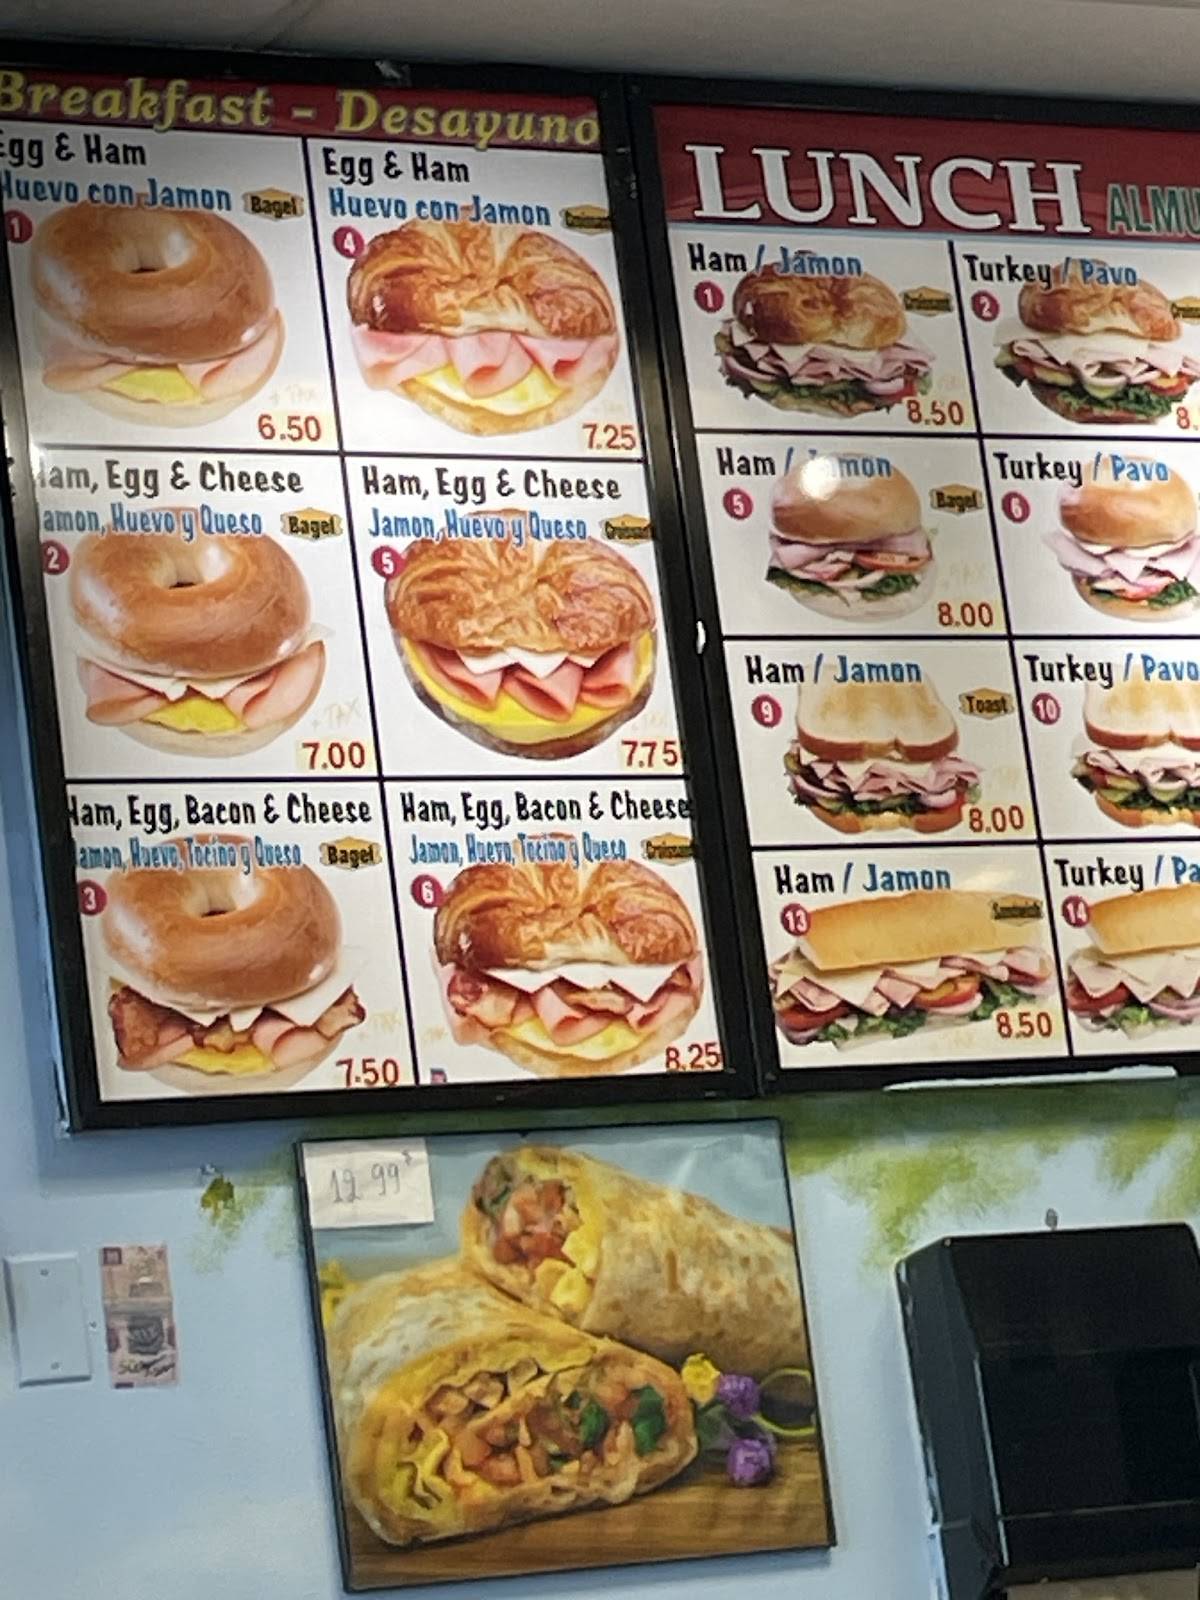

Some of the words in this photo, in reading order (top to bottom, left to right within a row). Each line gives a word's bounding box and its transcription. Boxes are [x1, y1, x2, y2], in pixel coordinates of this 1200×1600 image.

[0, 70, 273, 132] Breakfast
[335, 88, 599, 151] Desayuno
[55, 132, 75, 161] &
[84, 134, 147, 166] Ham
[323, 148, 374, 186] Egg
[384, 150, 402, 179] &
[412, 153, 470, 182] Ham
[88, 181, 133, 202] con
[145, 178, 232, 211] Jamon
[685, 144, 1092, 235] LUNCH
[250, 196, 297, 217] Bagel
[329, 188, 407, 220] Huevo
[416, 200, 457, 220] con
[472, 195, 551, 226] Jamon
[11, 217, 20, 239] 1
[343, 231, 356, 254] 4
[688, 242, 747, 272] Ham
[755, 244, 765, 274] /
[778, 246, 862, 276] Jamon
[963, 254, 1052, 289] Turkey
[1062, 256, 1072, 283] /
[1080, 258, 1137, 286] Pavo
[704, 288, 714, 308] 1
[979, 298, 992, 318] 2
[907, 401, 964, 425] 8.50
[258, 414, 321, 441] 6.50
[582, 424, 637, 450] 7.25
[716, 447, 776, 476] Ham
[785, 447, 794, 476] /
[808, 449, 892, 478] mon
[993, 452, 1082, 488] Turkey
[1093, 452, 1102, 481] /
[1110, 454, 1168, 482] Pavo
[106, 460, 159, 498] Egg
[171, 460, 190, 490] &
[200, 461, 304, 493] Cheese
[362, 466, 429, 500] Ham,
[435, 467, 486, 505] Egg
[497, 469, 515, 496] &
[524, 469, 622, 499] Cheese
[732, 494, 744, 515] 5
[1011, 497, 1022, 517] 6
[43, 510, 106, 537] amon,
[111, 503, 174, 533] Huevo
[181, 512, 196, 541] y
[201, 505, 262, 535] Queso
[289, 515, 336, 539] Bagel
[368, 508, 441, 541] Jamon,
[446, 509, 504, 538] Huevo
[512, 517, 525, 546] y
[529, 511, 587, 540] Queso
[47, 549, 59, 571] 2
[382, 552, 394, 573] 5
[937, 602, 993, 627] 8.00
[745, 655, 804, 684] Ham
[813, 653, 824, 684] /
[833, 655, 922, 684] Jamon
[1023, 654, 1113, 690] Turkey
[1123, 653, 1133, 681] /
[1141, 654, 1200, 681] Pavo
[762, 703, 772, 722] 9
[966, 695, 1006, 713] Toast
[1036, 699, 1056, 720] 10
[302, 742, 365, 770] 7.00
[621, 740, 678, 768] 7.75
[128, 795, 180, 834] Egg,
[186, 795, 256, 826] Bacon
[264, 793, 280, 823] &
[287, 793, 372, 824] Cheese
[400, 792, 456, 826] Ham,
[460, 793, 511, 830] Egg,
[516, 793, 582, 821] Bacon
[589, 792, 605, 820] &
[610, 791, 692, 819] Cheese
[968, 805, 1024, 833] 8.00
[78, 847, 127, 872] amon,
[327, 845, 374, 869] Bagel
[774, 864, 835, 895] Ham
[843, 862, 853, 894] /
[863, 863, 951, 891] Jamon
[1054, 856, 1143, 892] Turkey
[1155, 855, 1164, 885] /
[84, 888, 97, 908] 3
[421, 881, 434, 903] 6
[785, 911, 807, 934] 13
[1068, 902, 1087, 923] 14
[996, 1012, 1052, 1039] 8.50
[665, 1043, 720, 1071] 8.25
[336, 1057, 399, 1087] 7.50
